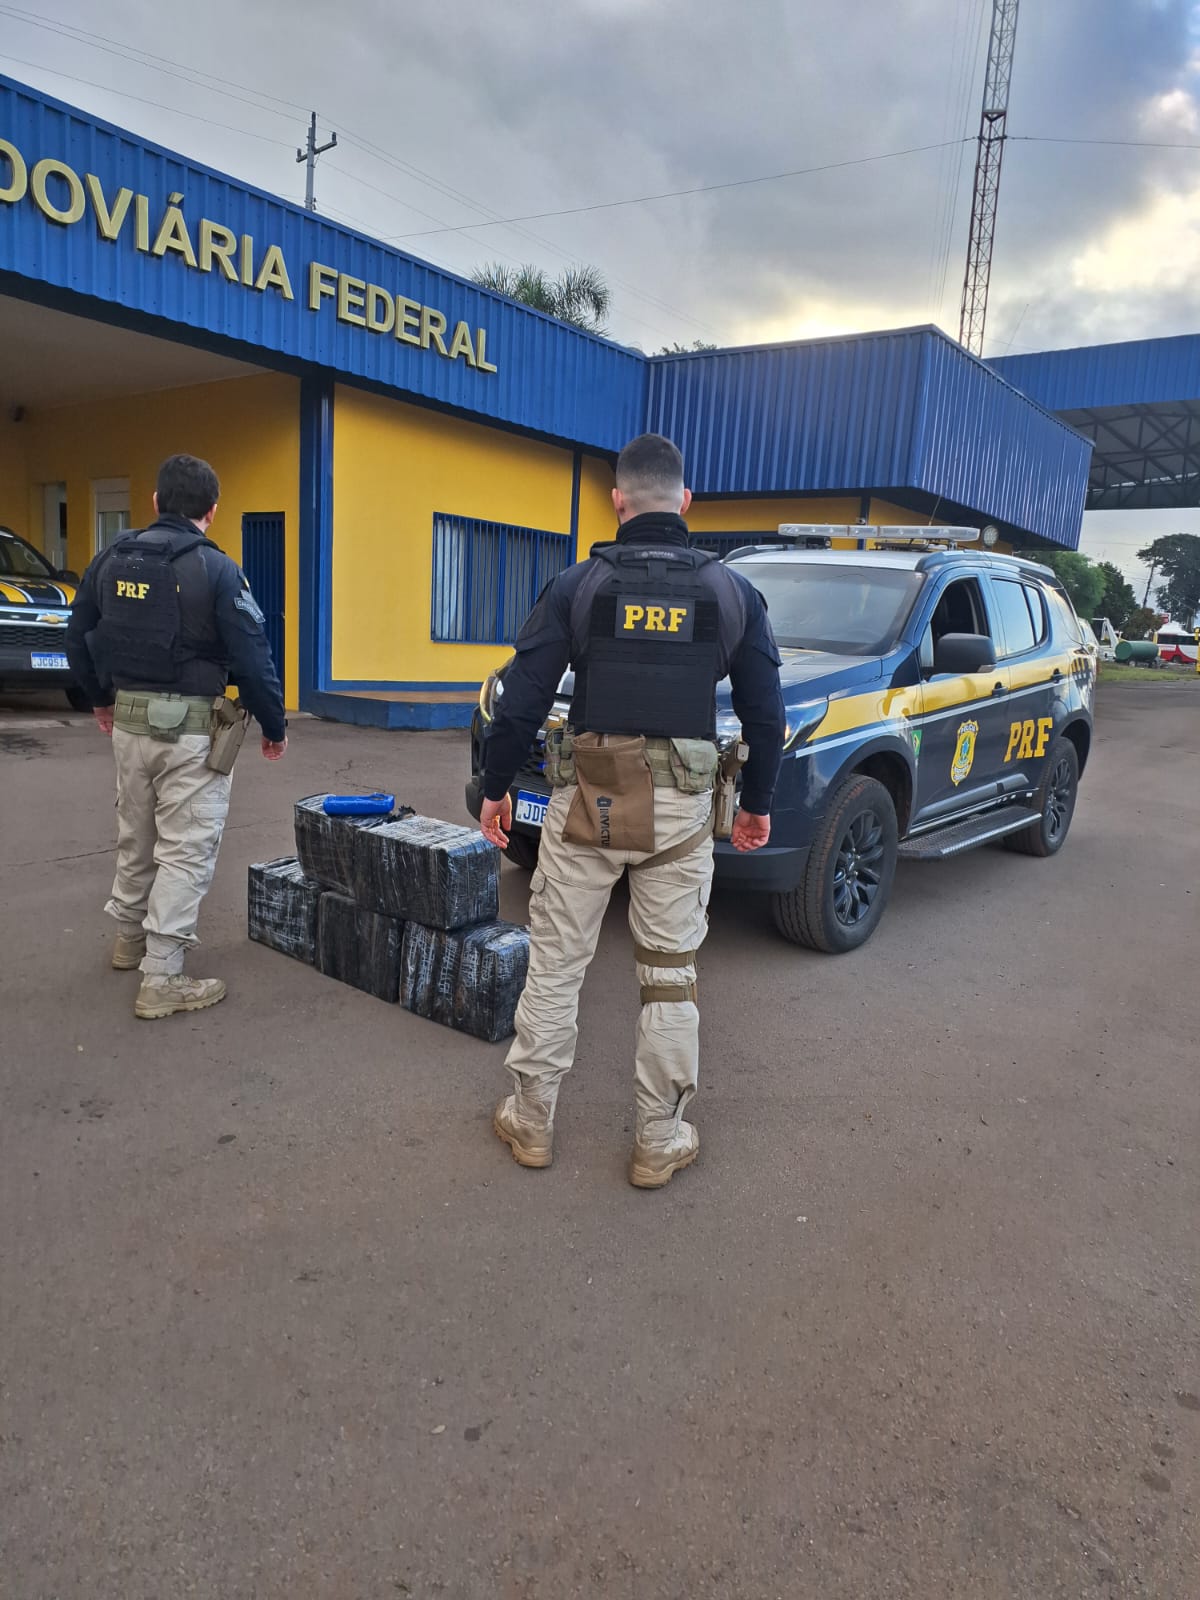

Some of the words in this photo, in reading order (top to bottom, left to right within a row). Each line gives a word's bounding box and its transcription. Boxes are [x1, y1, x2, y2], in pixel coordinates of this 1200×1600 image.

[309, 261, 498, 373] FEDERAL
[116, 580, 150, 599] PRF
[623, 605, 687, 632] PRF
[1003, 716, 1053, 762] PRF
